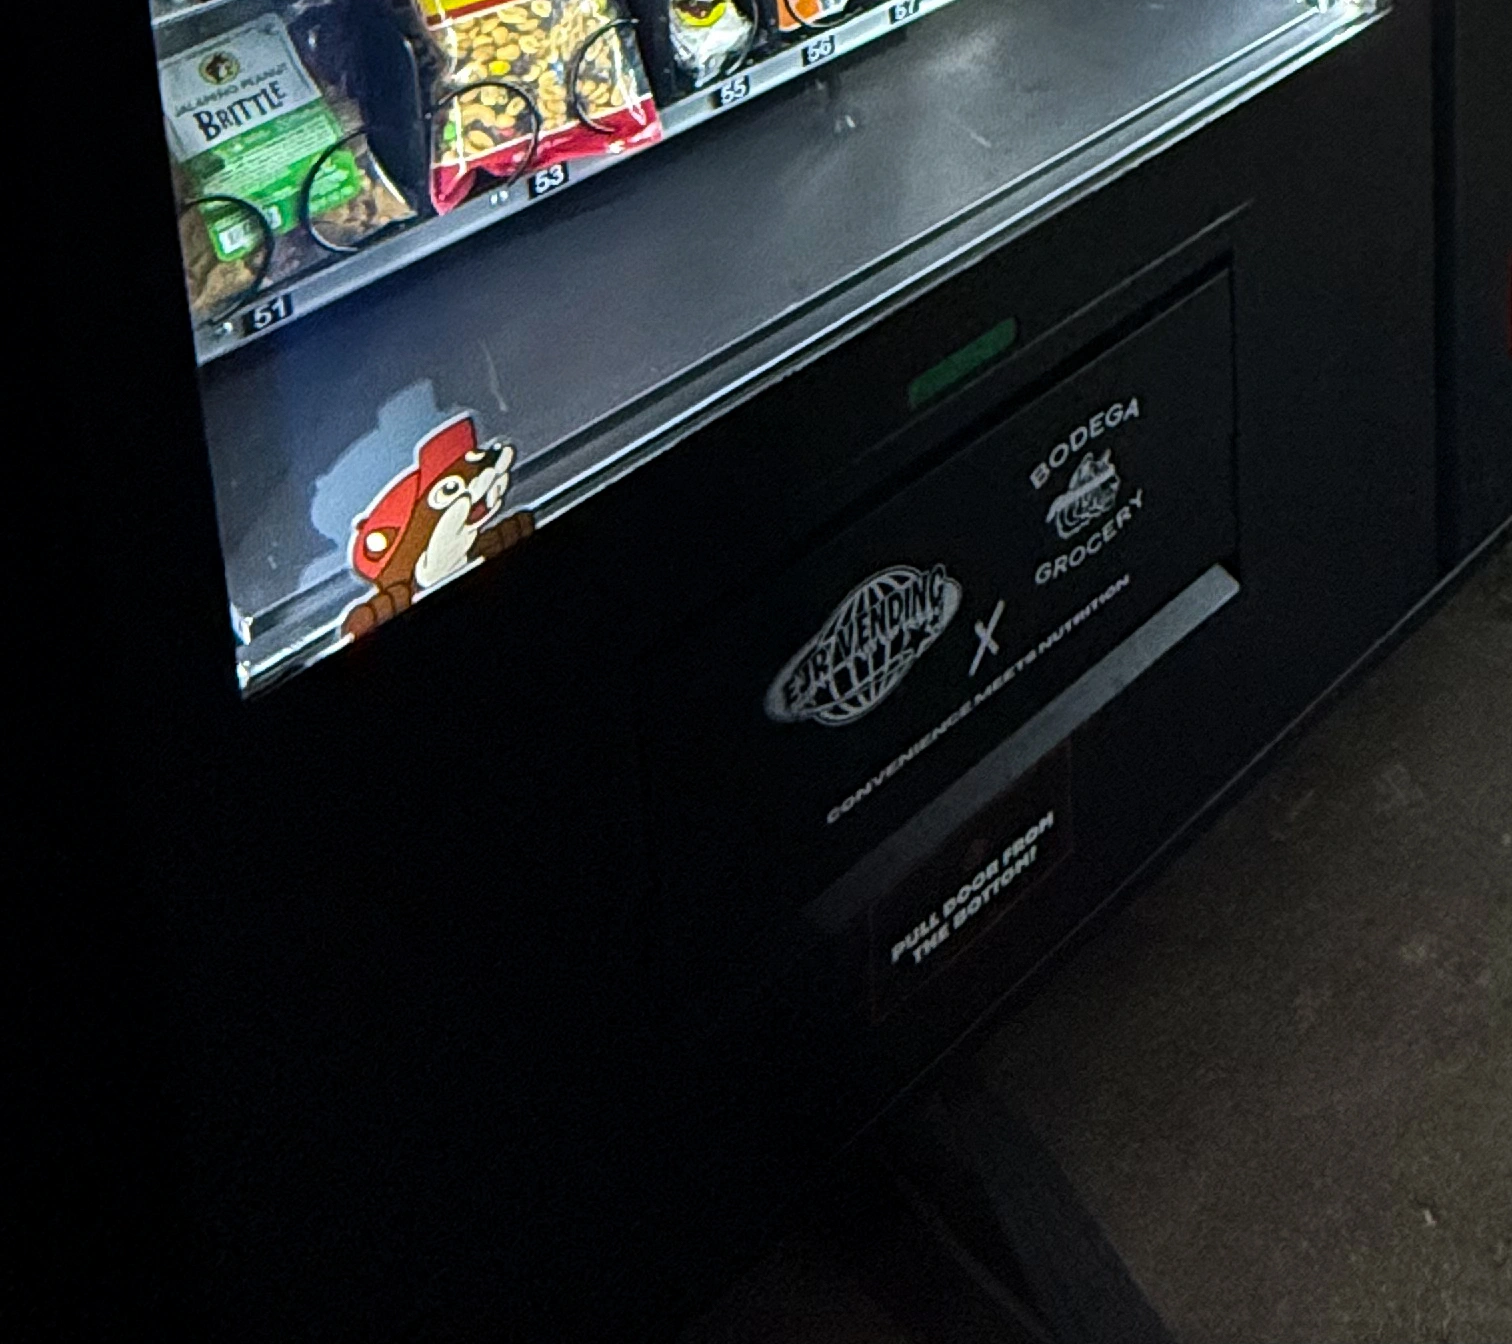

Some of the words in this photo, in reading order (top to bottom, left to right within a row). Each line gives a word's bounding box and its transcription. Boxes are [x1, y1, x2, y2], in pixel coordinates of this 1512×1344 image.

[805, 37, 832, 61] 56
[193, 79, 288, 143] BRITTLE
[720, 78, 748, 105] 55
[533, 164, 565, 194] 53
[251, 295, 289, 330] 51
[1028, 396, 1141, 492] BODEGA
[1033, 488, 1144, 587] GROCERY
[967, 599, 1006, 678] X
[826, 699, 974, 825] CONVENIENCE
[972, 650, 1038, 706] MEETS
[1035, 574, 1131, 662] NUTRITION
[890, 911, 941, 966] PULL
[941, 863, 1001, 916] DOOR
[1002, 810, 1056, 873] FROM
[911, 925, 952, 966] THE
[951, 843, 1041, 935] BOTTOM!
